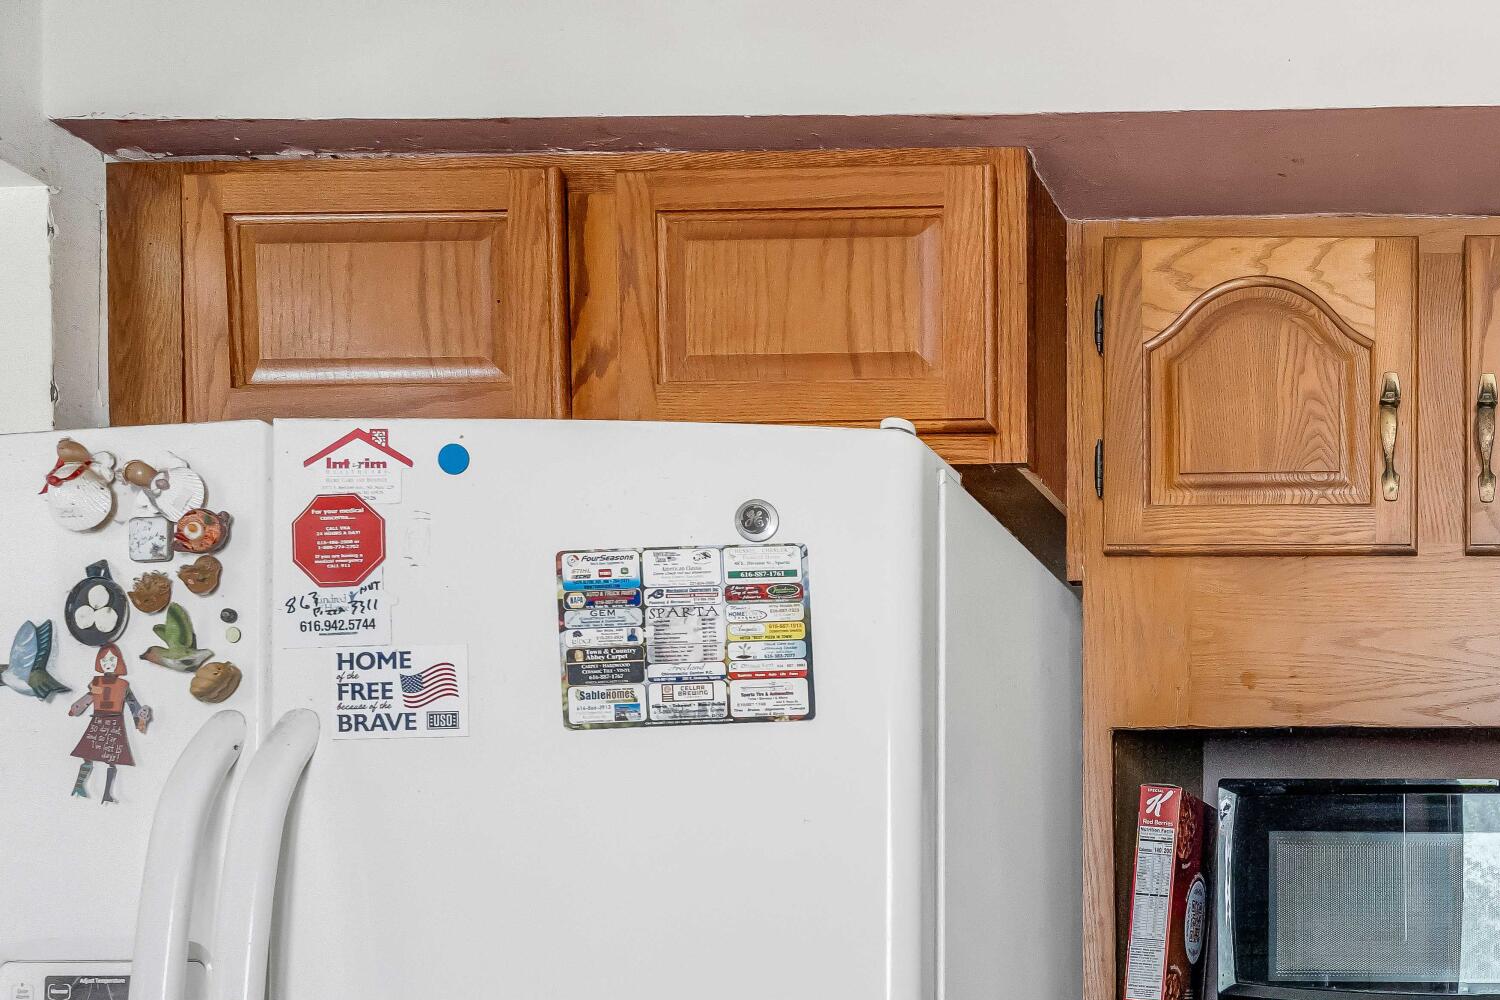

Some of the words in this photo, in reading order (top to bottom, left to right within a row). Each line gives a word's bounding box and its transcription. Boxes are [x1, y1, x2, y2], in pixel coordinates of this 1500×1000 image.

[590, 609, 616, 617] GEM
[649, 606, 720, 619] SPARTA
[300, 618, 375, 632] 616.942.5744
[336, 651, 412, 671] HOME
[336, 671, 345, 682] of
[346, 670, 359, 680] the
[336, 682, 393, 701] FREE
[337, 702, 367, 711] because
[369, 702, 377, 712] of
[380, 701, 392, 709] the
[337, 712, 417, 733] BRAVE
[433, 714, 453, 727] USO
[1145, 790, 1174, 817] K
